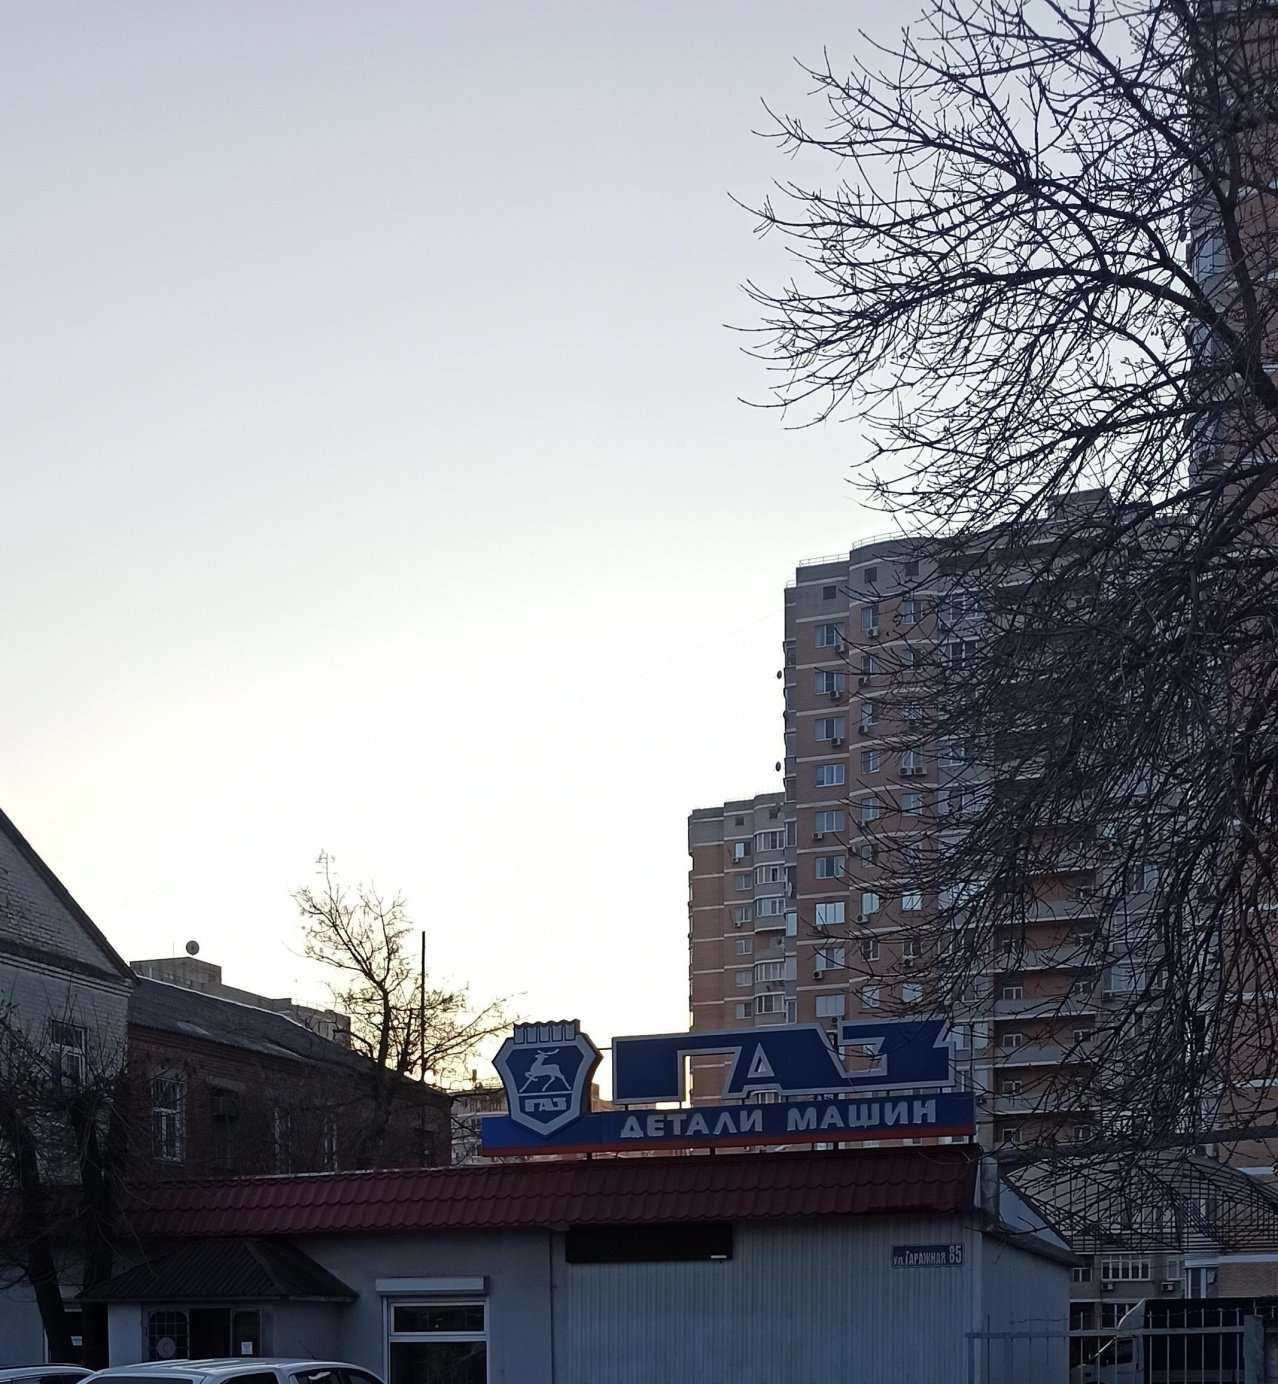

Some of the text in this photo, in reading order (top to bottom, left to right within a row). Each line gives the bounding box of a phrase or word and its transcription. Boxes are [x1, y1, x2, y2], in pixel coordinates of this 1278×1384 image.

[612, 1018, 957, 1104] ГАЗ
[524, 1097, 567, 1112] ГАЗ
[619, 1099, 938, 1139] ДЕТАЛИ МАШИН
